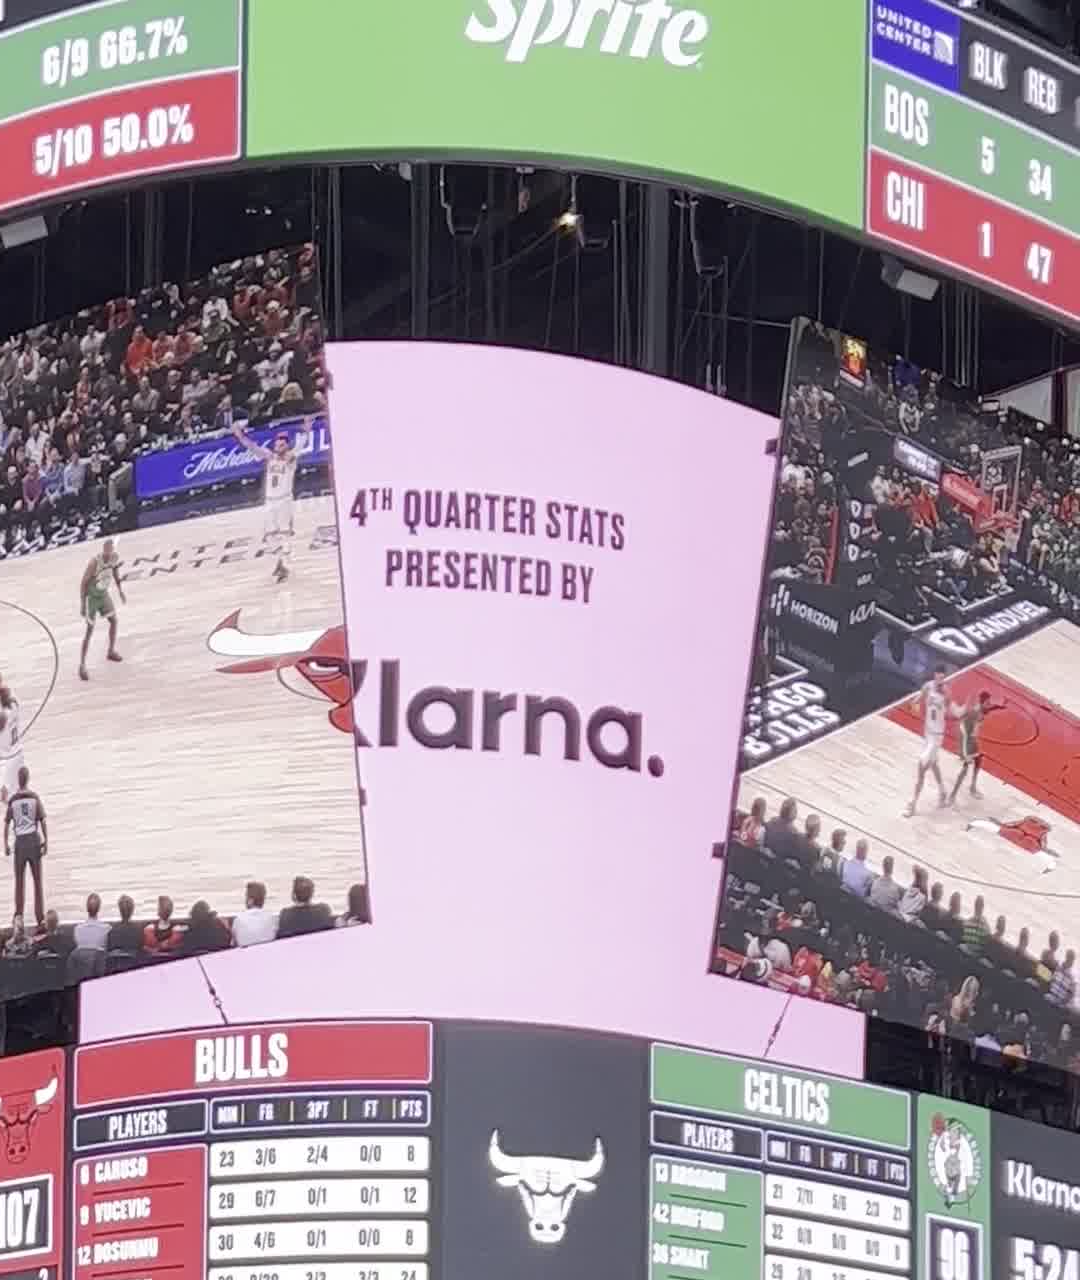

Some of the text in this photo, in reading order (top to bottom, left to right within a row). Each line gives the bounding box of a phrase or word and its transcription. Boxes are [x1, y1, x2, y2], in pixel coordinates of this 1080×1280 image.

[464, 0, 709, 66] Sprite
[876, 21, 931, 56] CENTER
[877, 4, 932, 39] UNITED
[41, 15, 188, 88] 6/9 66.7%
[972, 41, 1008, 90] BLK
[1027, 66, 1059, 115] REB
[884, 83, 929, 147] BOS
[33, 103, 195, 178] 5/10 50.0%
[980, 135, 995, 175] 5
[885, 171, 925, 231] CHI
[1029, 158, 1053, 202] 34
[980, 221, 992, 258] 1
[1027, 242, 1053, 285] 47
[349, 487, 626, 551] 4TH QUARTER STATS
[385, 549, 595, 604] PRESENTED BY
[790, 598, 839, 636] HORIZON
[965, 598, 1051, 643] FANDUEL
[194, 1032, 289, 1083] BULLS
[217, 1099, 423, 1124] MIN 3PT FT PTS
[743, 1068, 830, 1126] CELTICS
[108, 1109, 168, 1140] PLAYERS
[683, 1123, 734, 1153] PLAYERS
[219, 1150, 235, 1168] 23
[307, 1144, 329, 1164] 2/4
[360, 1143, 382, 1163] 0/0
[307, 1185, 327, 1205] 0/1
[360, 1186, 380, 1204] 0/1
[403, 1185, 417, 1203] 12
[218, 1233, 234, 1251] 30
[307, 1228, 327, 1247] 0/1
[358, 1228, 381, 1246] 0/0
